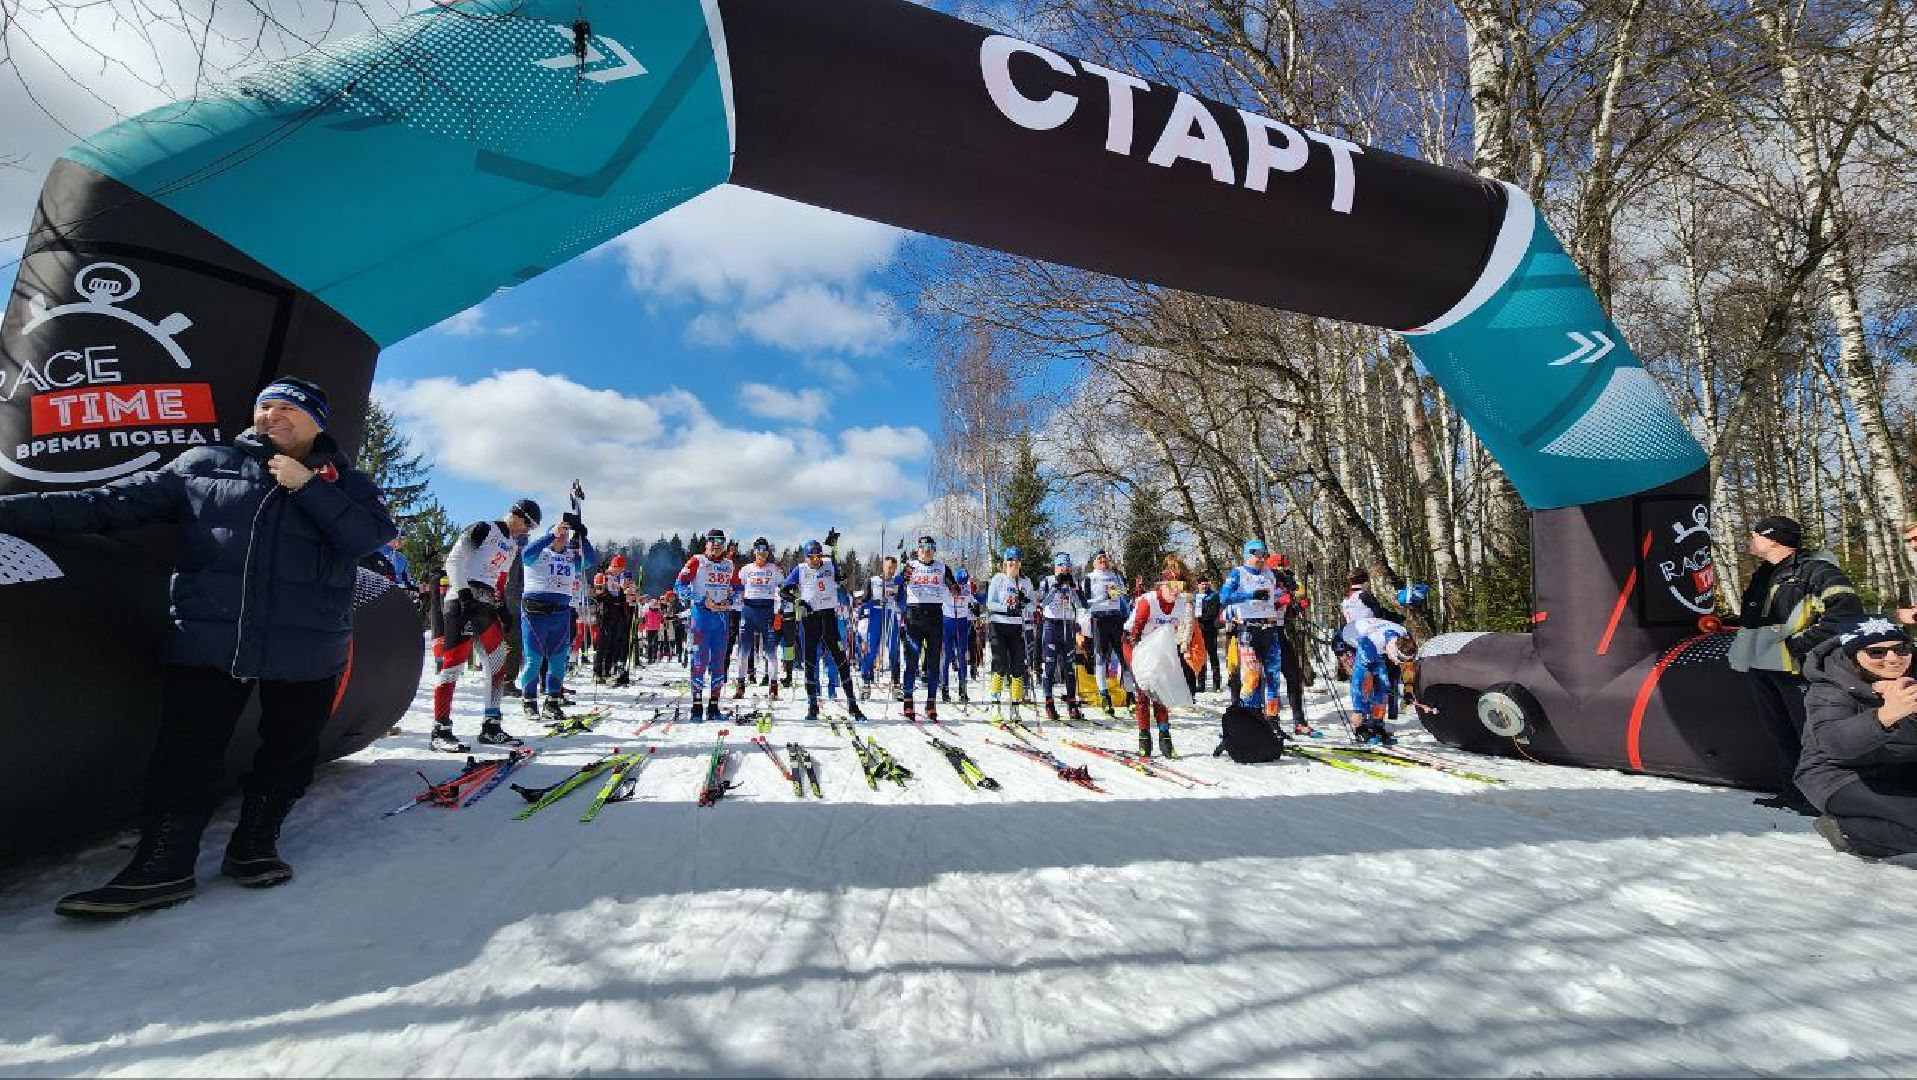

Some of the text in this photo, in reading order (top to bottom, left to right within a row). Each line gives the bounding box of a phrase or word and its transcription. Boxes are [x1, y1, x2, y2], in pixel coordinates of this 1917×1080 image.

[980, 34, 1365, 214] СТАРТ
[49, 389, 188, 427] TIME
[16, 432, 101, 460] ВРЕМЯ
[109, 429, 207, 447] ПОБЕД
[548, 563, 571, 577] 128
